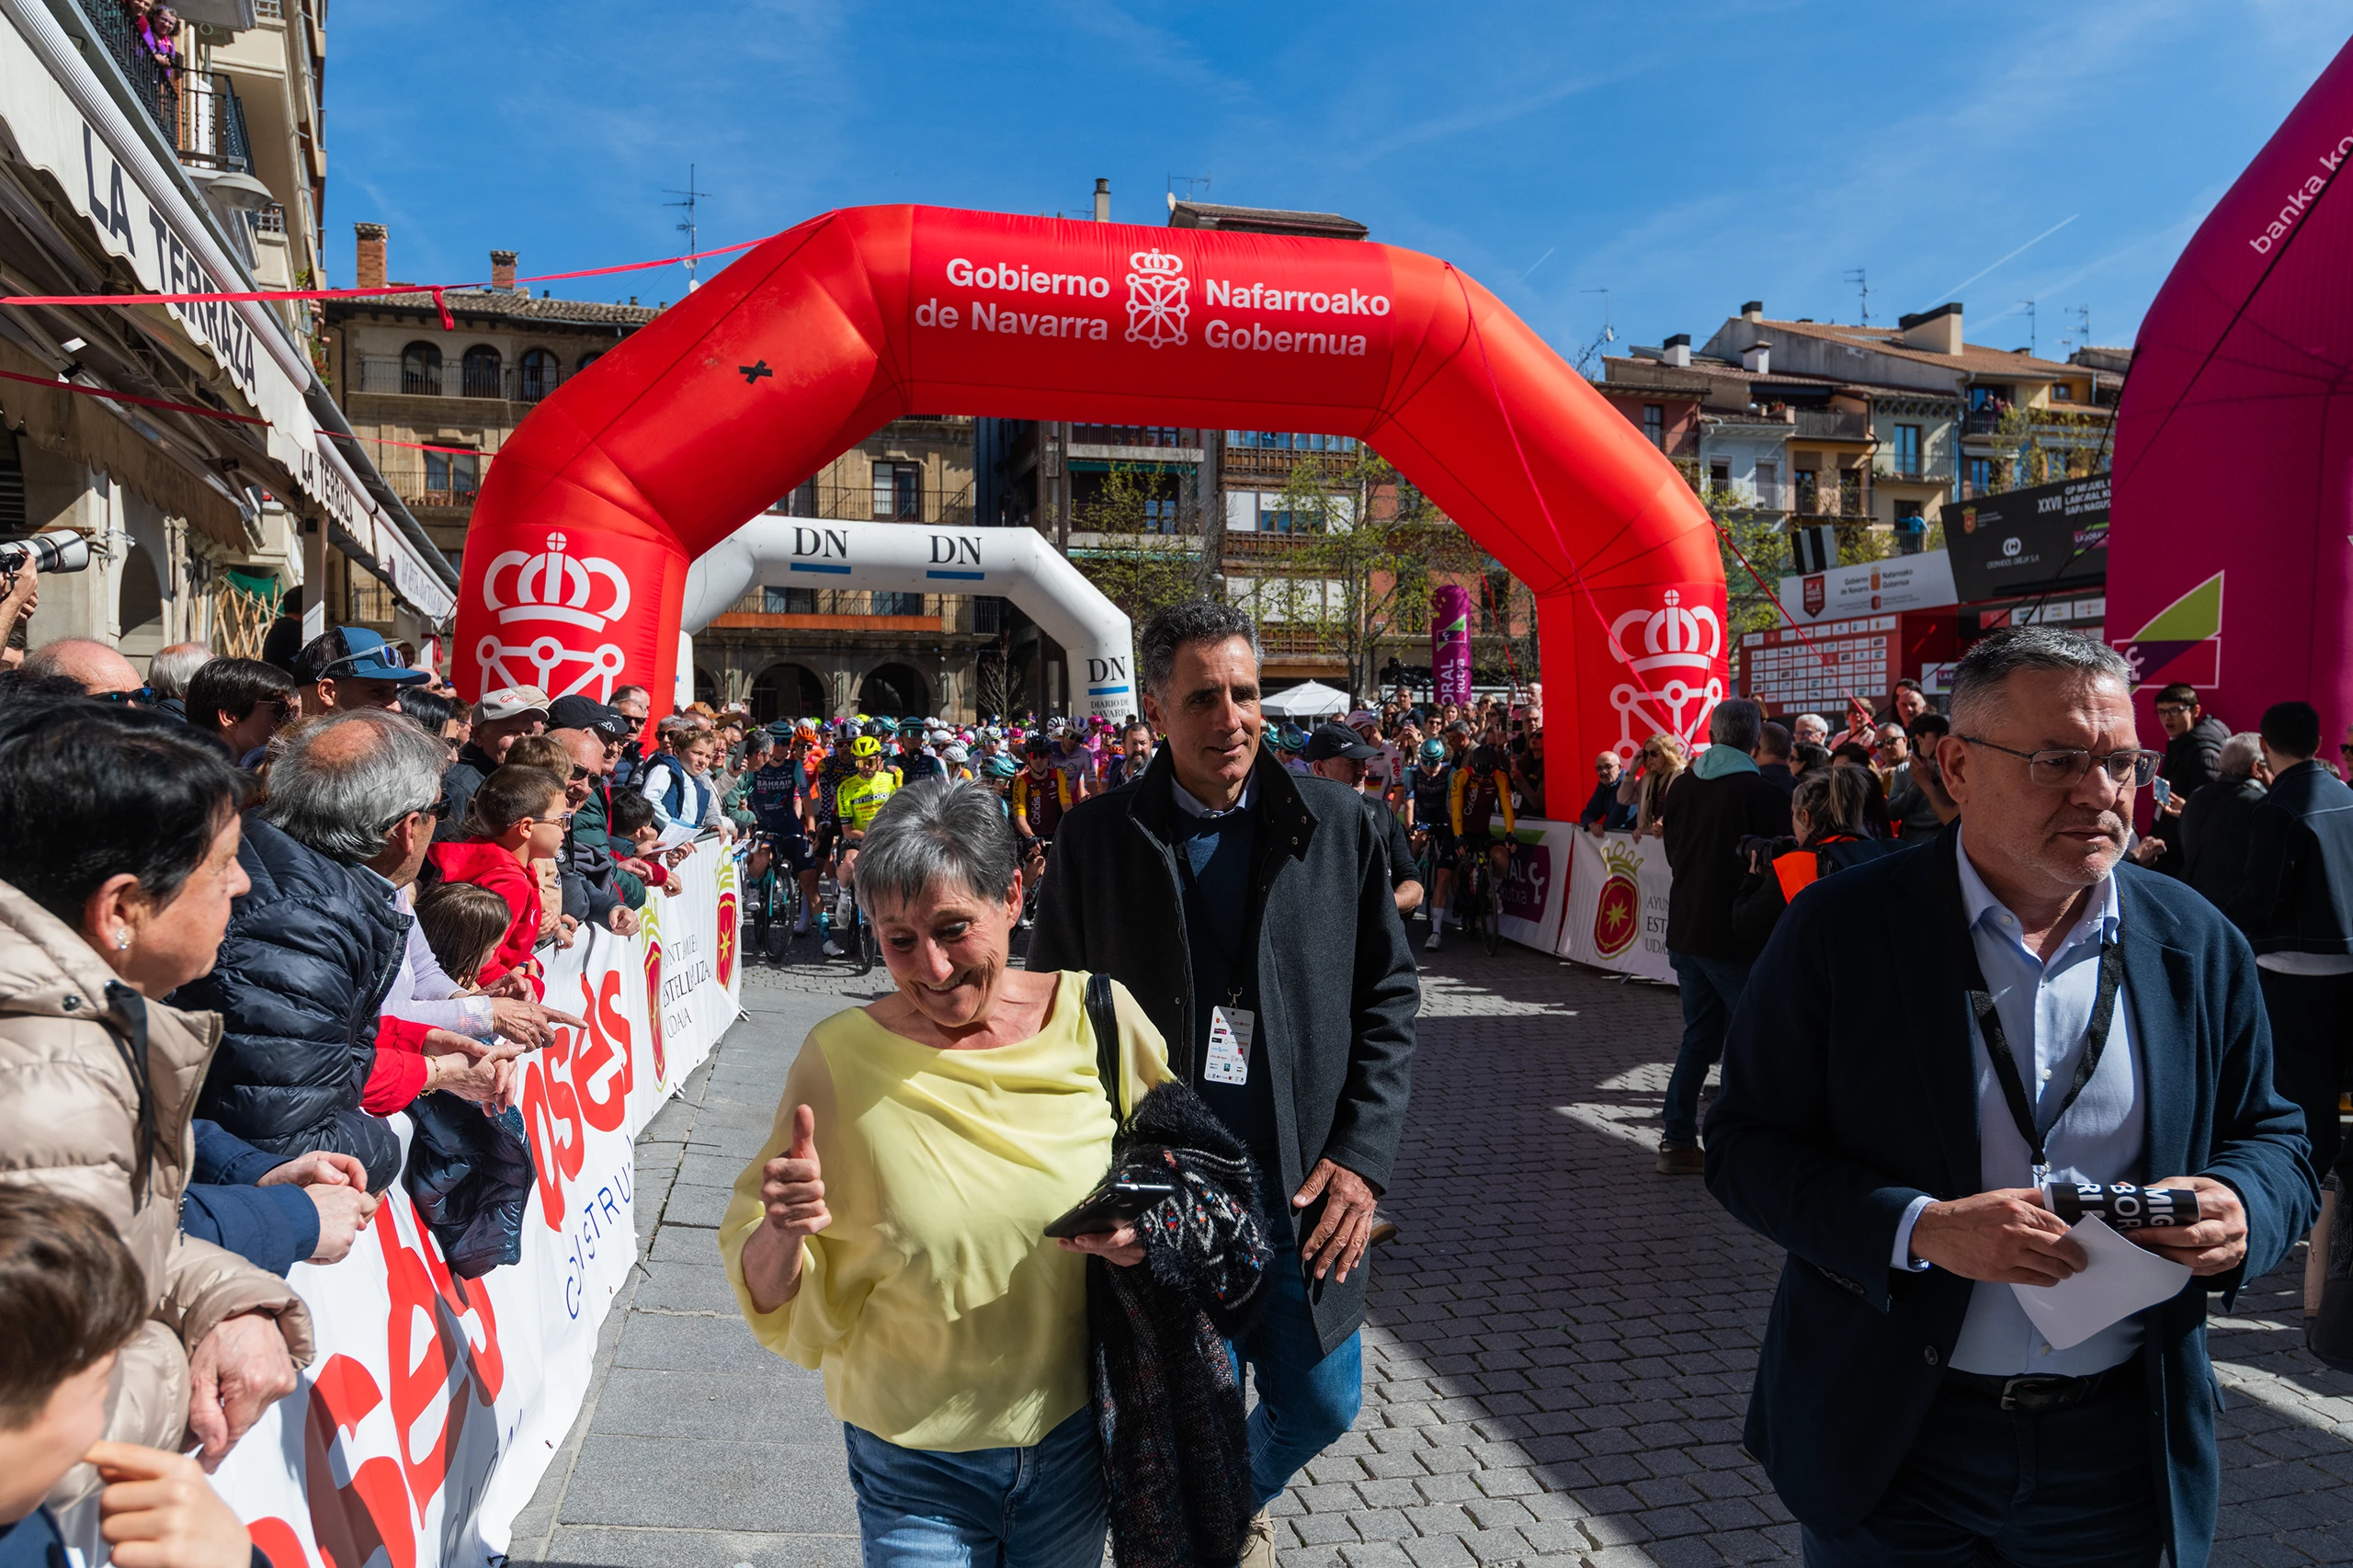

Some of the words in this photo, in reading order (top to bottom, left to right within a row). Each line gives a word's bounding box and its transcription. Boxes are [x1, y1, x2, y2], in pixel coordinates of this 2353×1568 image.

[2249, 175, 2327, 255] banka
[2319, 128, 2353, 172] ko
[83, 120, 136, 258] LA
[148, 204, 256, 395] TERRAZA
[947, 258, 1110, 299] Gobierno
[1206, 278, 1391, 317] Nafarroako
[915, 298, 959, 329] de
[972, 301, 1108, 341] Navarra
[1205, 319, 1367, 357] Gobernua
[301, 449, 314, 488] LA
[319, 460, 354, 528] TERRAZA
[791, 527, 849, 559] DN
[927, 535, 983, 564] DN
[1086, 656, 1125, 683] DN
[1456, 658, 1466, 693] kutxa
[1090, 699, 1120, 709] DIARIO
[1092, 709, 1131, 718] NAVARRA
[853, 792, 890, 804] anicolor
[1030, 796, 1040, 824] Cofidis
